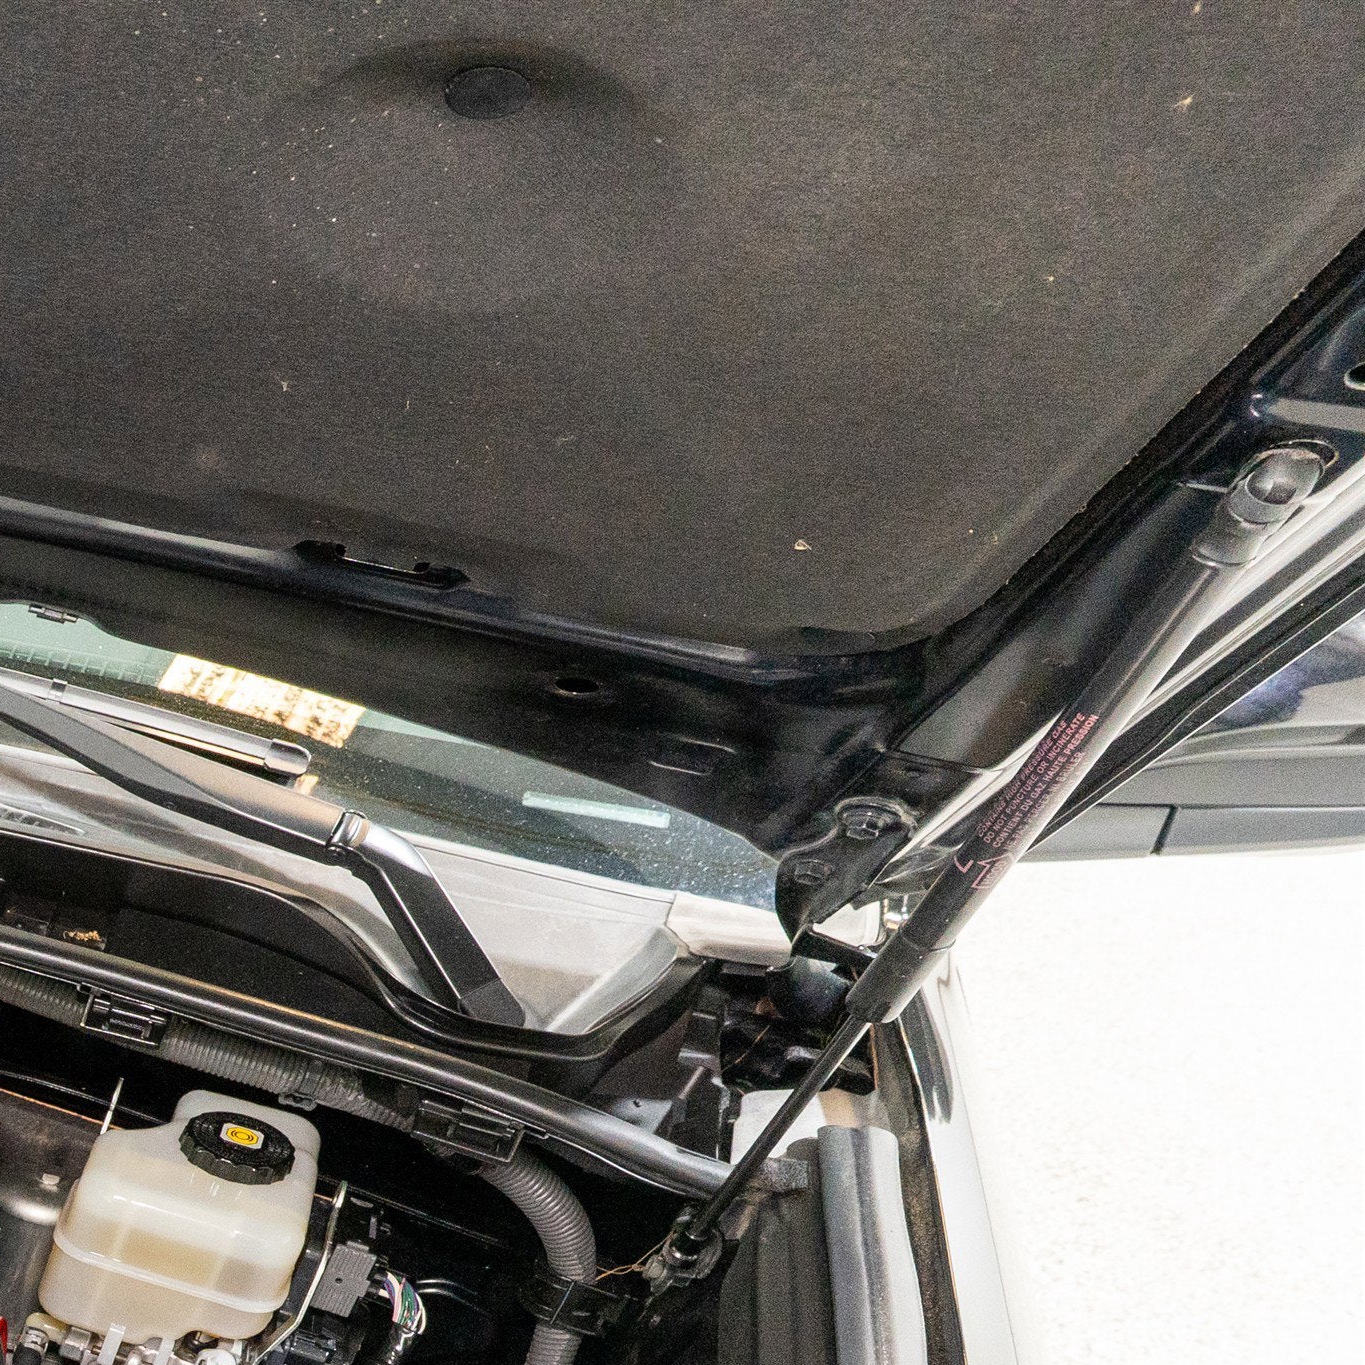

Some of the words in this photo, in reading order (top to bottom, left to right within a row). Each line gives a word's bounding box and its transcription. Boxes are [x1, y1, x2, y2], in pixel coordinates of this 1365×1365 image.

[977, 800, 1006, 837] CONTAINS
[1019, 738, 1053, 781] PRESSURE
[1050, 719, 1067, 739] GAS
[983, 830, 995, 843] DO
[992, 814, 1007, 831] NOT
[1005, 772, 1039, 815] PUNCTURE
[1036, 760, 1049, 774] OR
[1046, 711, 1085, 761] INCINERATE
[992, 810, 1023, 849] CONTIENT
[1020, 798, 1033, 812] DU
[1030, 781, 1046, 799] GAZ
[1042, 754, 1067, 783] HAUTE
[1063, 712, 1099, 756] PRESSION
